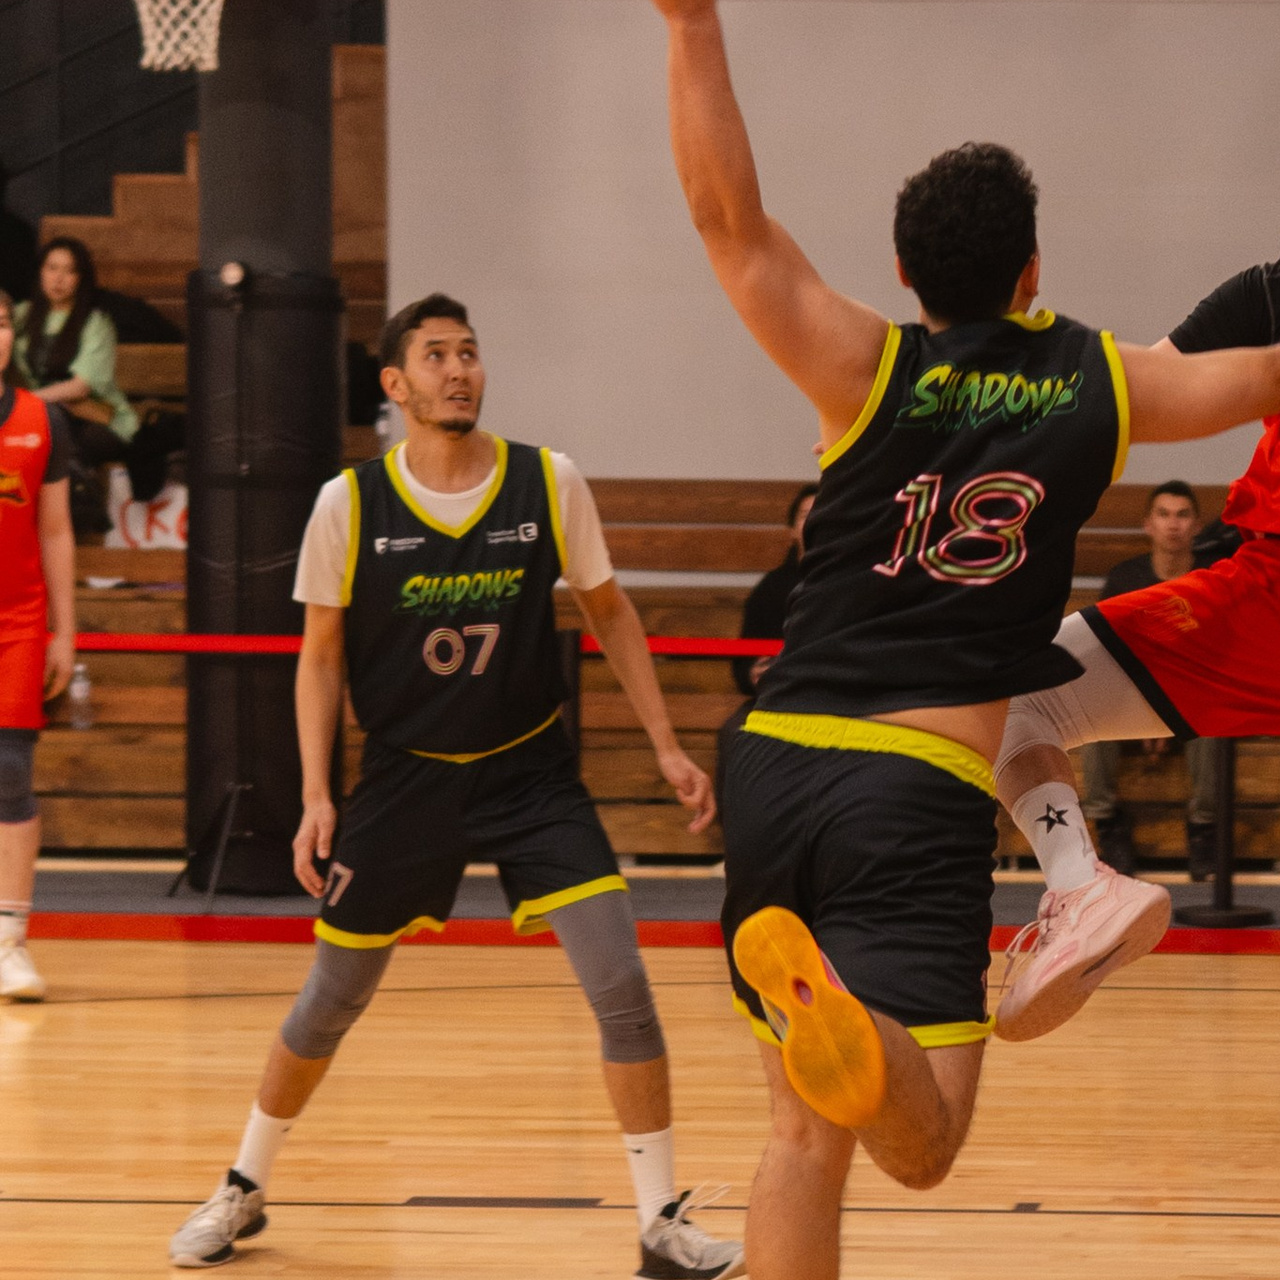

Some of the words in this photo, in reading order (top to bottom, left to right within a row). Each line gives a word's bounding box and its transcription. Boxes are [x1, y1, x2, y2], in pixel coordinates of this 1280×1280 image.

[872, 471, 1045, 586] 18
[401, 569, 525, 608] SHADOWS
[423, 624, 500, 676] 07
